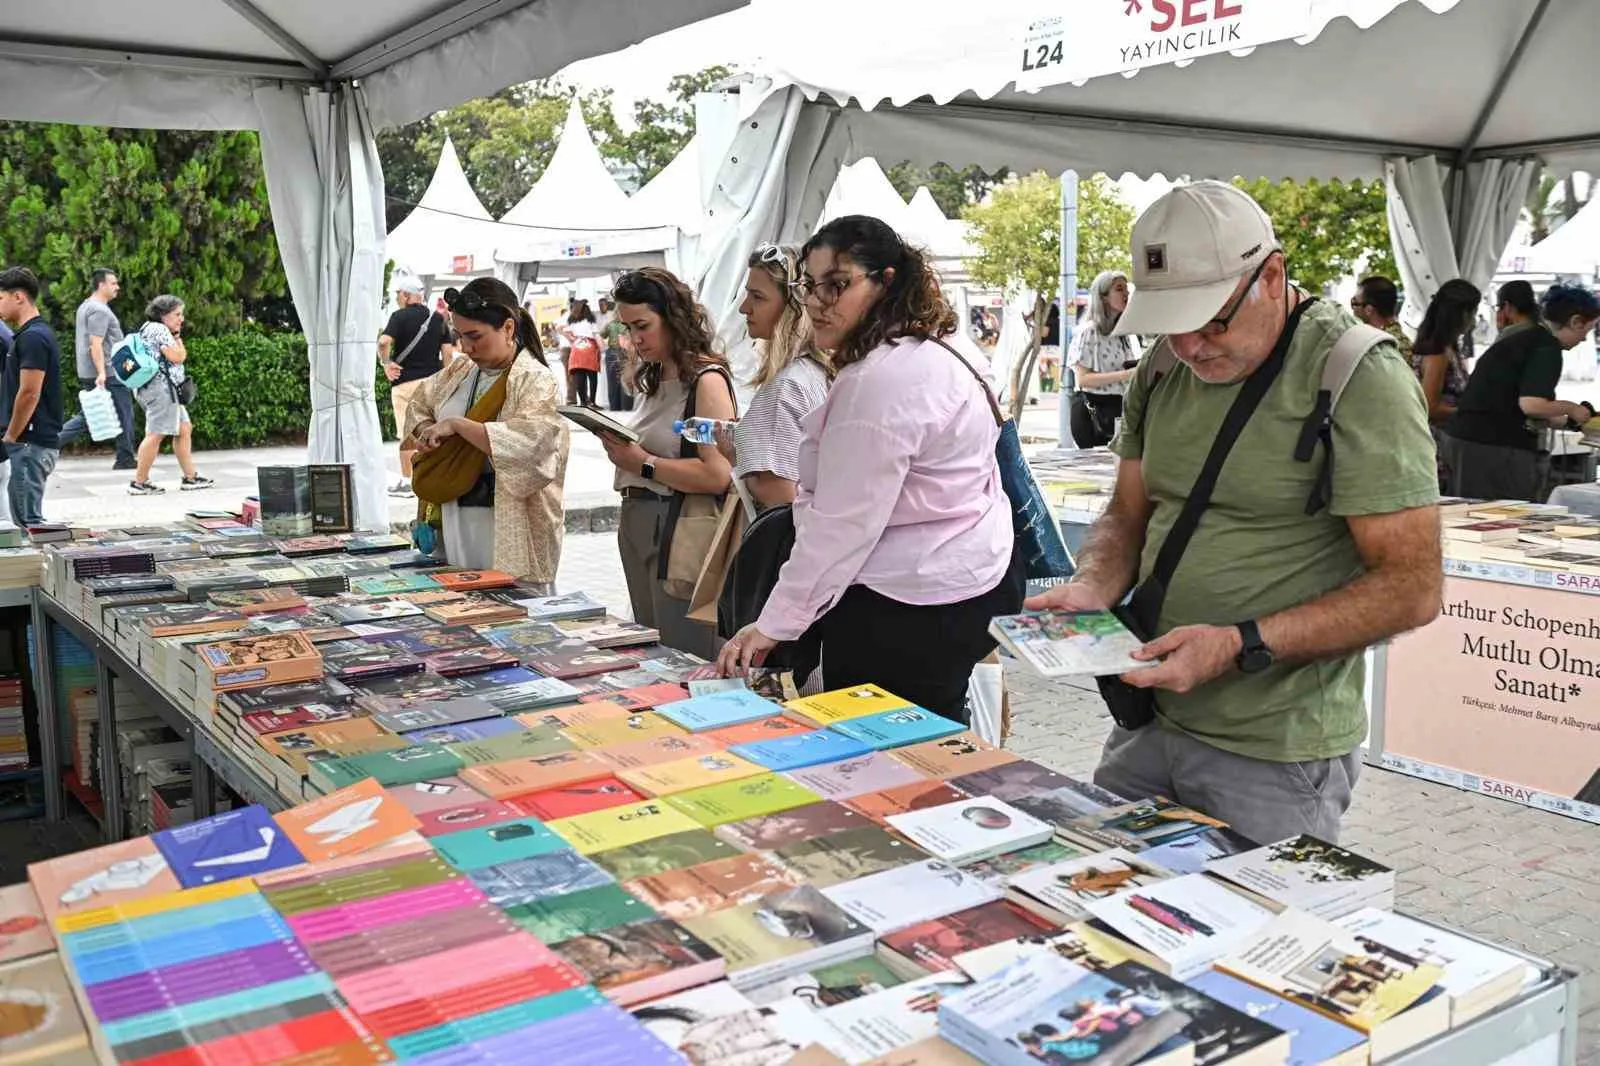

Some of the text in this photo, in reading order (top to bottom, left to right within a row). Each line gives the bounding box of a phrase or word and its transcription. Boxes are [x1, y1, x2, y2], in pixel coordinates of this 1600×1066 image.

[1022, 39, 1064, 72] L24
[1119, 22, 1241, 63] YAYINCILIK
[1461, 632, 1532, 666] Mutlu
[1499, 703, 1534, 719] Mehmet
[1482, 780, 1537, 802] SARAY
